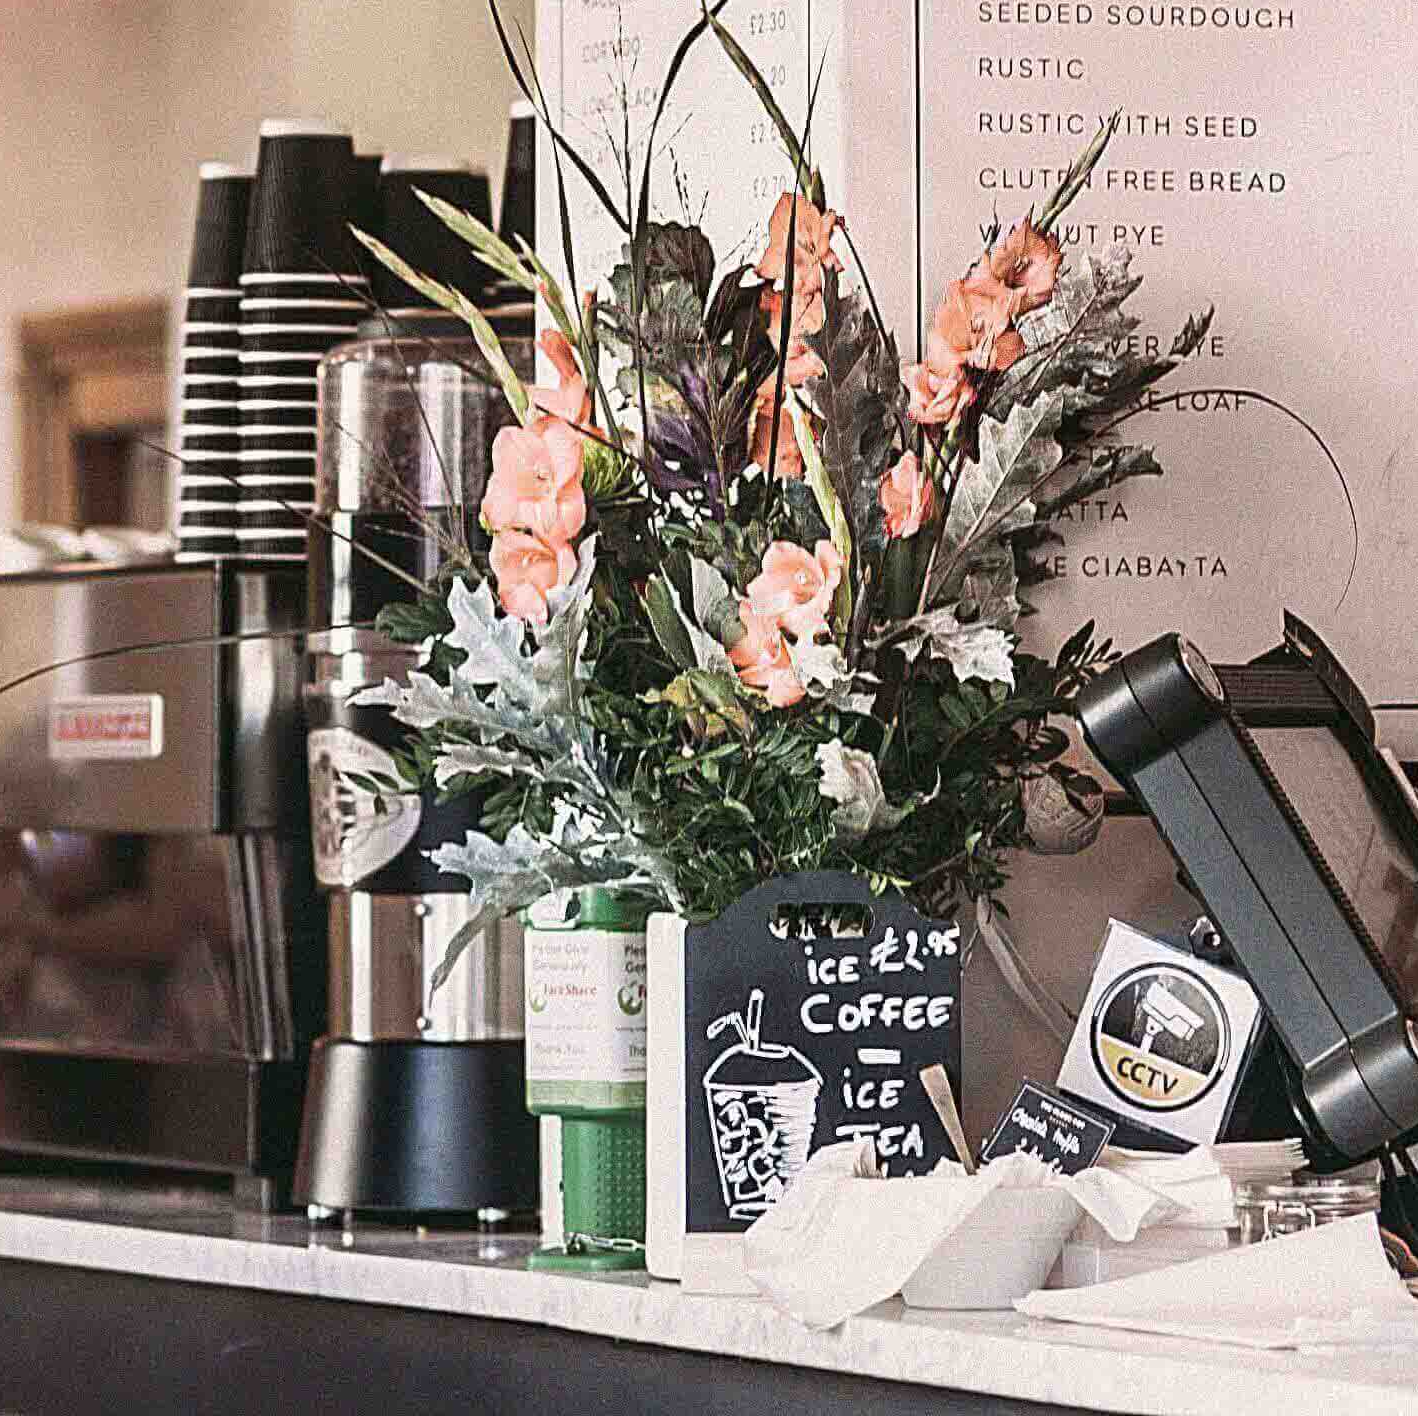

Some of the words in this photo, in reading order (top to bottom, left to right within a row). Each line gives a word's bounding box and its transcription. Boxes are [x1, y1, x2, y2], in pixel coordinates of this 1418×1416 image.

[978, 0, 1094, 25] SEEDED
[1106, 4, 1294, 30] SOURDOUGH
[978, 56, 1084, 81] RUSTIC
[978, 111, 1084, 136] RUSTIC
[1184, 115, 1258, 139] SEED
[1106, 169, 1175, 193] FREE
[1188, 170, 1287, 194] BREAD
[1081, 555, 1229, 578] CIABATTA
[1115, 1056, 1179, 1096] CCTV
